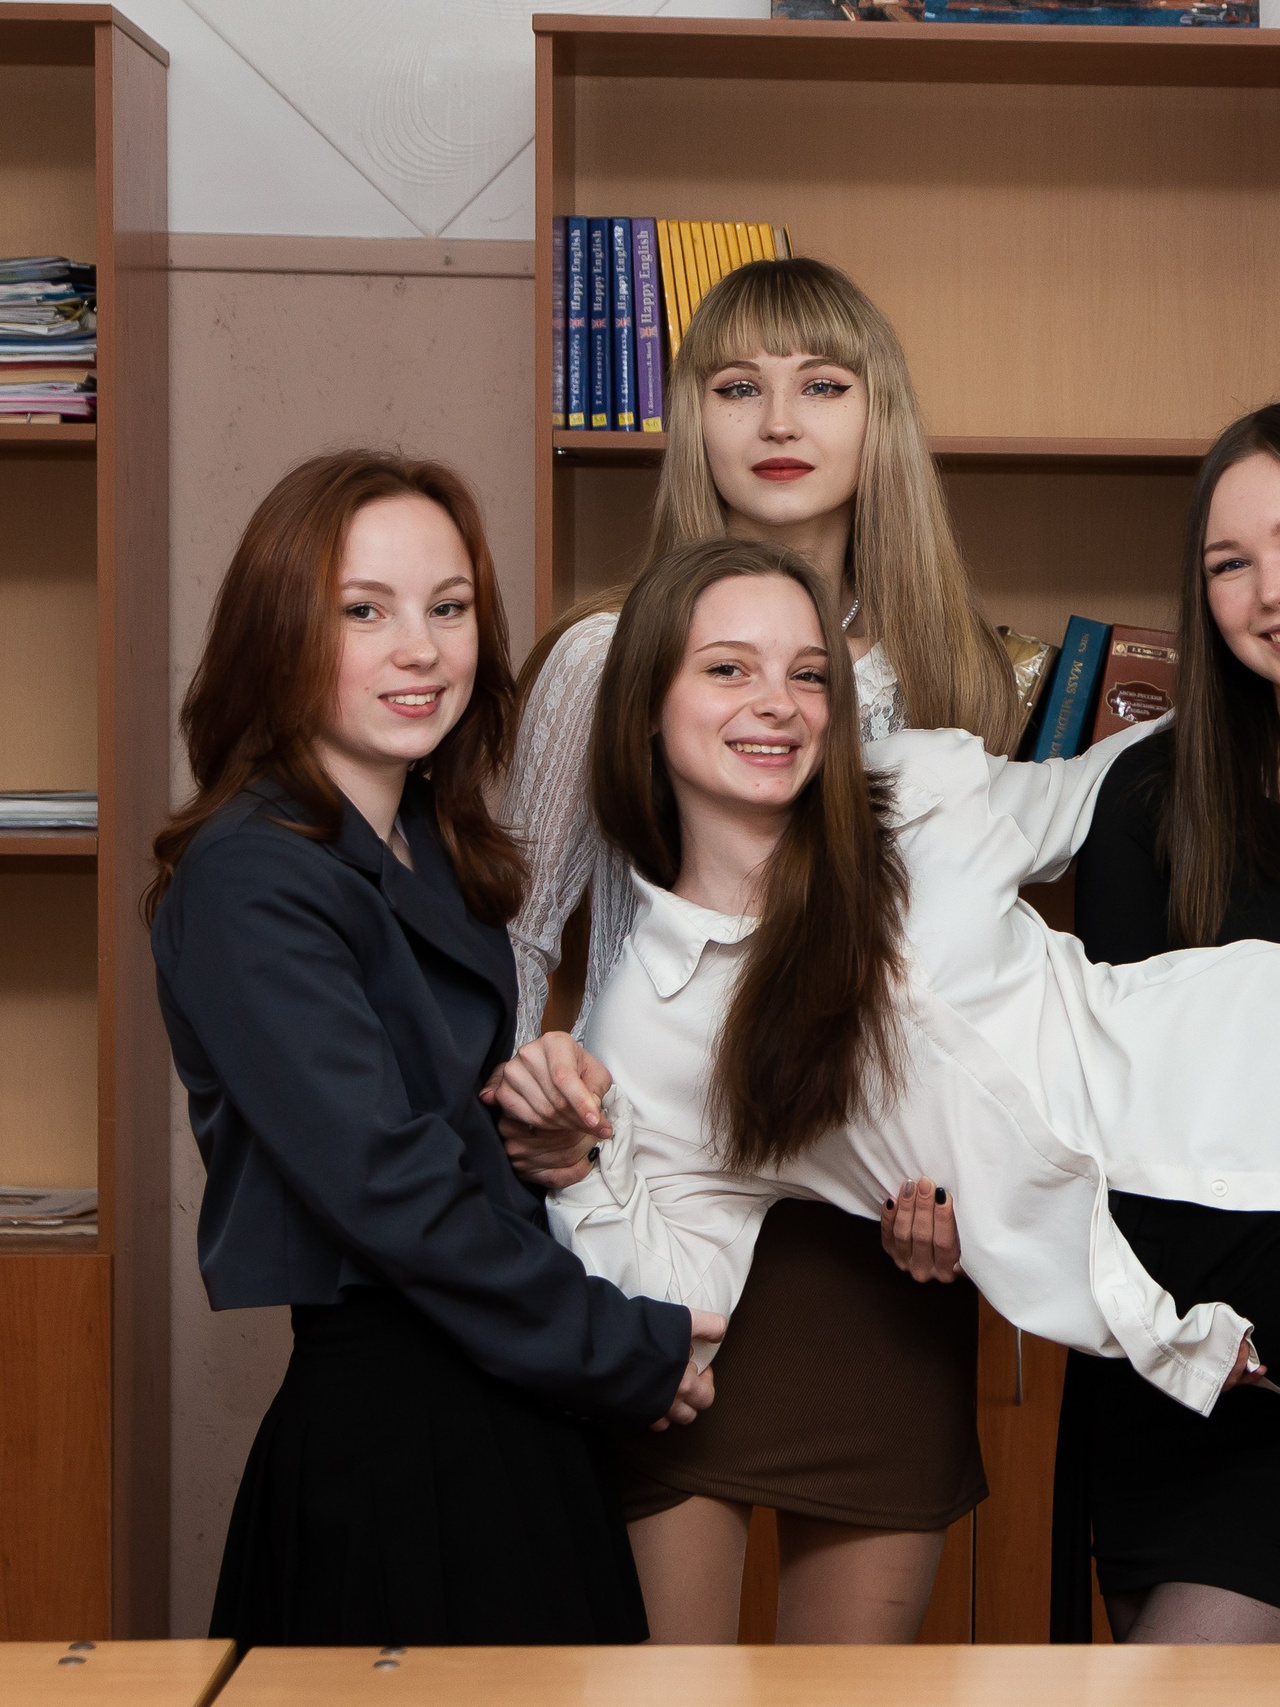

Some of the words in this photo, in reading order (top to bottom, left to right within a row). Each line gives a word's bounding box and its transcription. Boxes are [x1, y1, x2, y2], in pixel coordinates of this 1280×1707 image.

[570, 229, 584, 272] English
[592, 230, 604, 274] English
[614, 228, 627, 272] English
[637, 230, 654, 279] English
[570, 274, 583, 310] Happy
[592, 276, 604, 312] Happy
[617, 274, 629, 310] Happy
[640, 281, 656, 324] Happy
[1065, 659, 1085, 695] MASS
[1054, 697, 1074, 739] MEDIA
